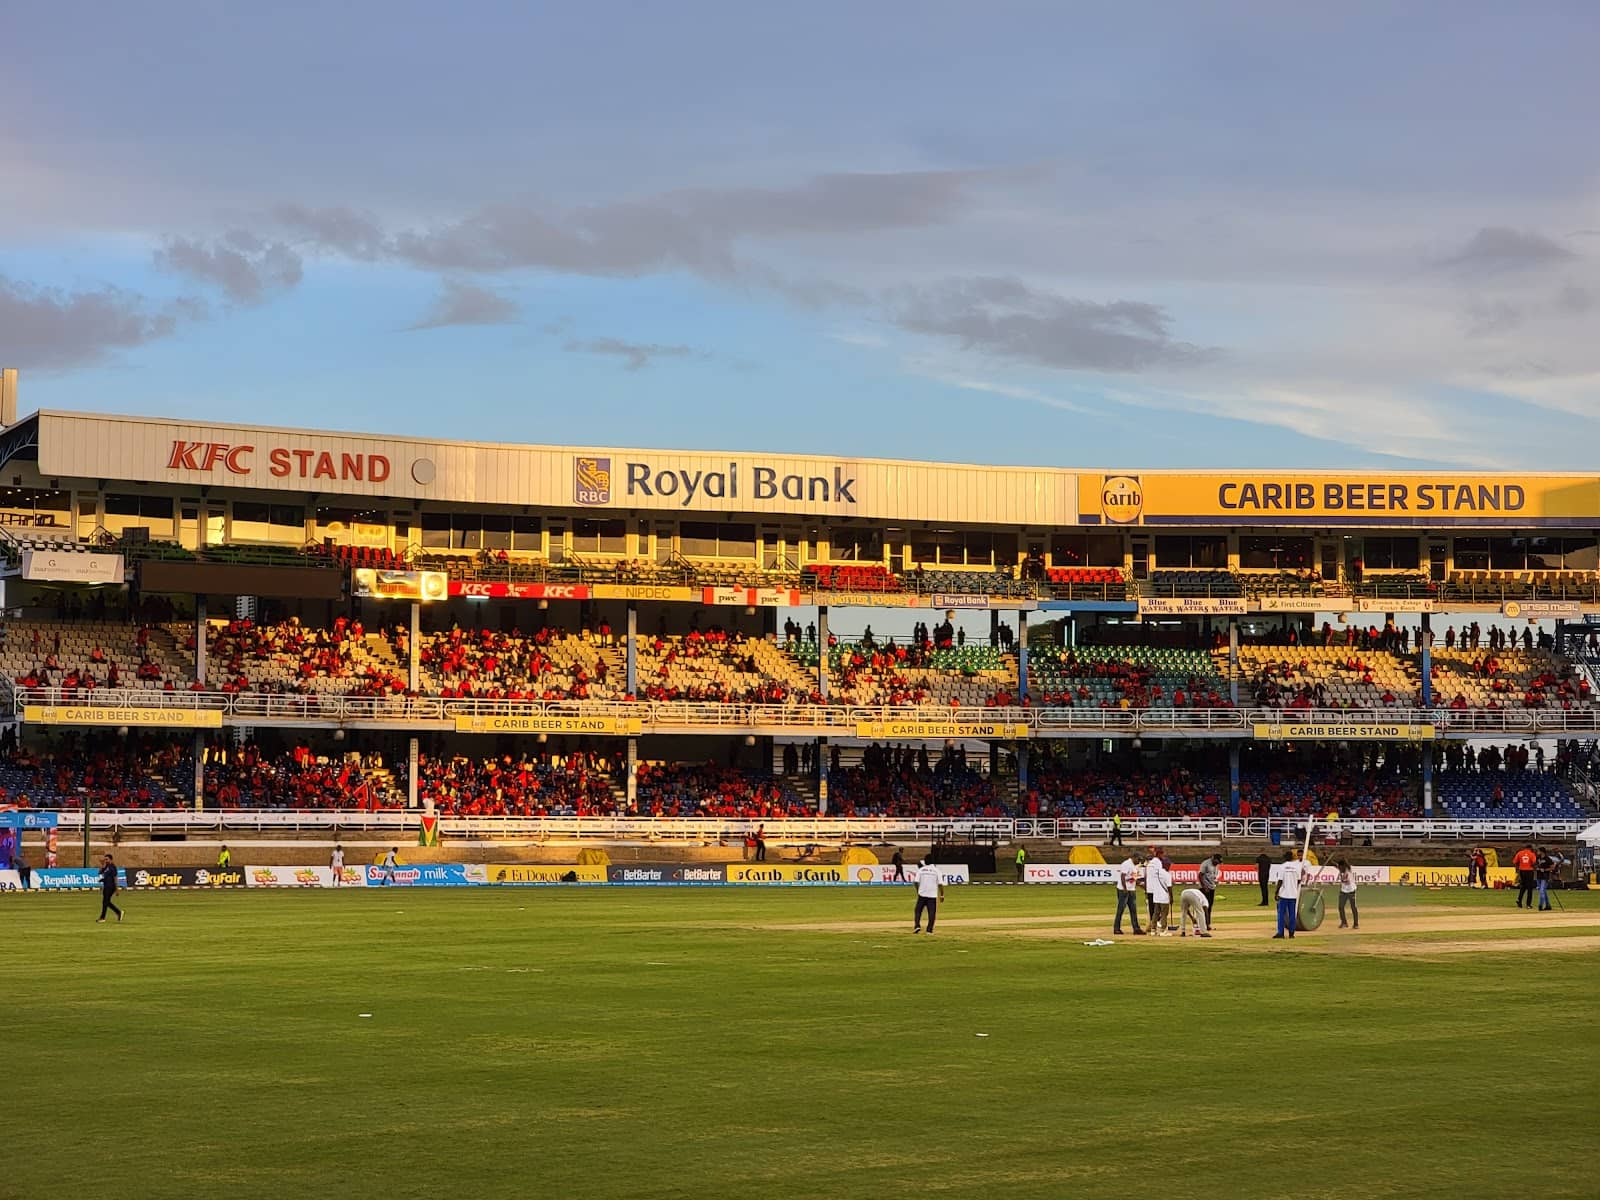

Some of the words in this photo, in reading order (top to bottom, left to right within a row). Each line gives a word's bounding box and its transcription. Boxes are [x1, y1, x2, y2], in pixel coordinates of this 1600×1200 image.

[167, 440, 254, 475] KFC
[269, 448, 391, 482] STAND
[625, 462, 738, 506] Royal
[753, 466, 857, 503] Bank
[579, 491, 608, 502] RBC
[1103, 490, 1141, 505] Carib
[1218, 483, 1315, 510] CARIB
[1323, 484, 1408, 510] BEER
[1416, 484, 1525, 511] STAND
[459, 583, 492, 595] KFC
[543, 585, 575, 597] KFC
[626, 587, 672, 599] NIPDEC
[944, 596, 966, 605] Royal
[66, 710, 104, 720] CARIB
[107, 711, 139, 721] BEER
[143, 712, 184, 722] STAND
[494, 719, 529, 728] CARIB
[533, 720, 562, 729] BEER
[566, 721, 605, 730] STAND
[892, 726, 924, 734] CARIB
[928, 726, 955, 734] BEER
[958, 726, 994, 735] STAND
[1290, 727, 1325, 736] CARIB
[1328, 727, 1356, 736] BEER
[1357, 727, 1399, 736] STAND
[369, 867, 420, 880] Sannah
[425, 868, 448, 880] milk
[527, 869, 563, 882] DORAD
[623, 869, 662, 880] BetBarter
[684, 868, 722, 880] BetBarter
[745, 869, 782, 881] Carib
[803, 869, 841, 881] Carib
[1029, 869, 1054, 878] TCL
[1059, 869, 1112, 878] COURTS
[1223, 870, 1259, 881] DREAM
[1431, 871, 1469, 884] DORAD
[43, 875, 81, 887] Republic
